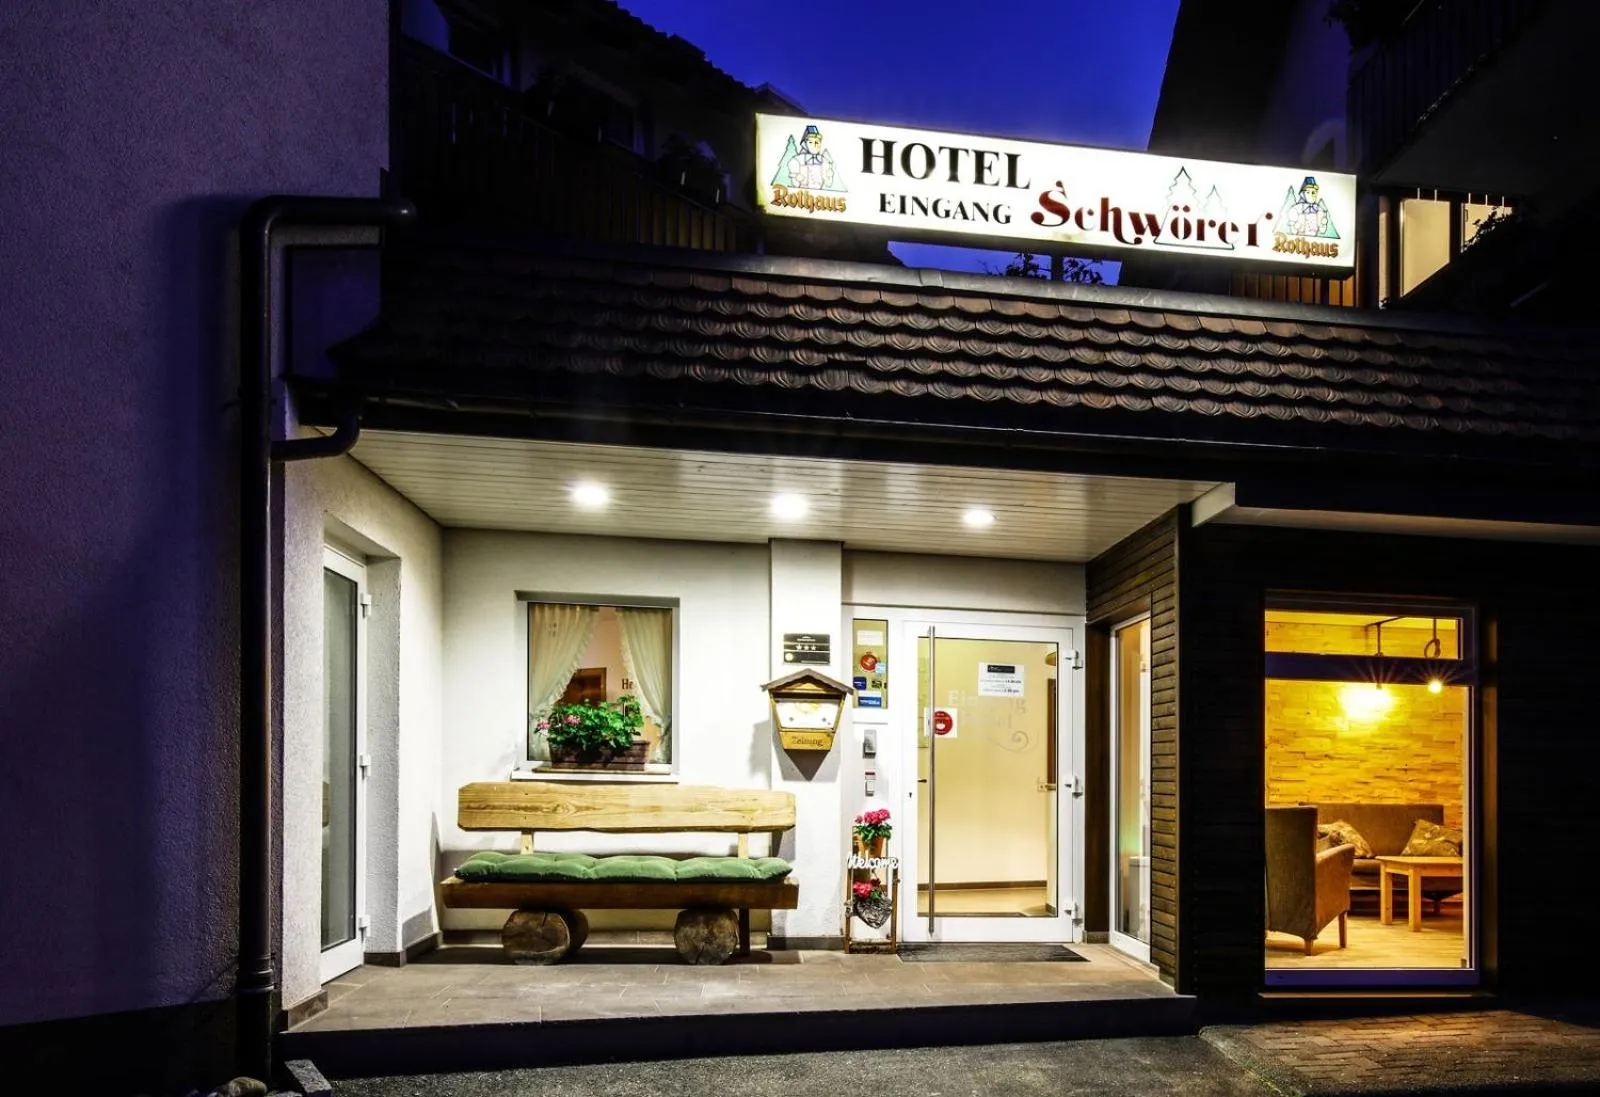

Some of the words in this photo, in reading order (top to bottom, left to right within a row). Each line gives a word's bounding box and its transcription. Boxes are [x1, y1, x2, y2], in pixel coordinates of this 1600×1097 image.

[859, 137, 1031, 190] HOTEL
[770, 183, 847, 214] Rothaus
[879, 193, 1012, 225] EINGANG
[1030, 180, 1274, 246] Schwörer
[1272, 231, 1340, 259] Rothaus
[846, 852, 900, 870] Welcome
